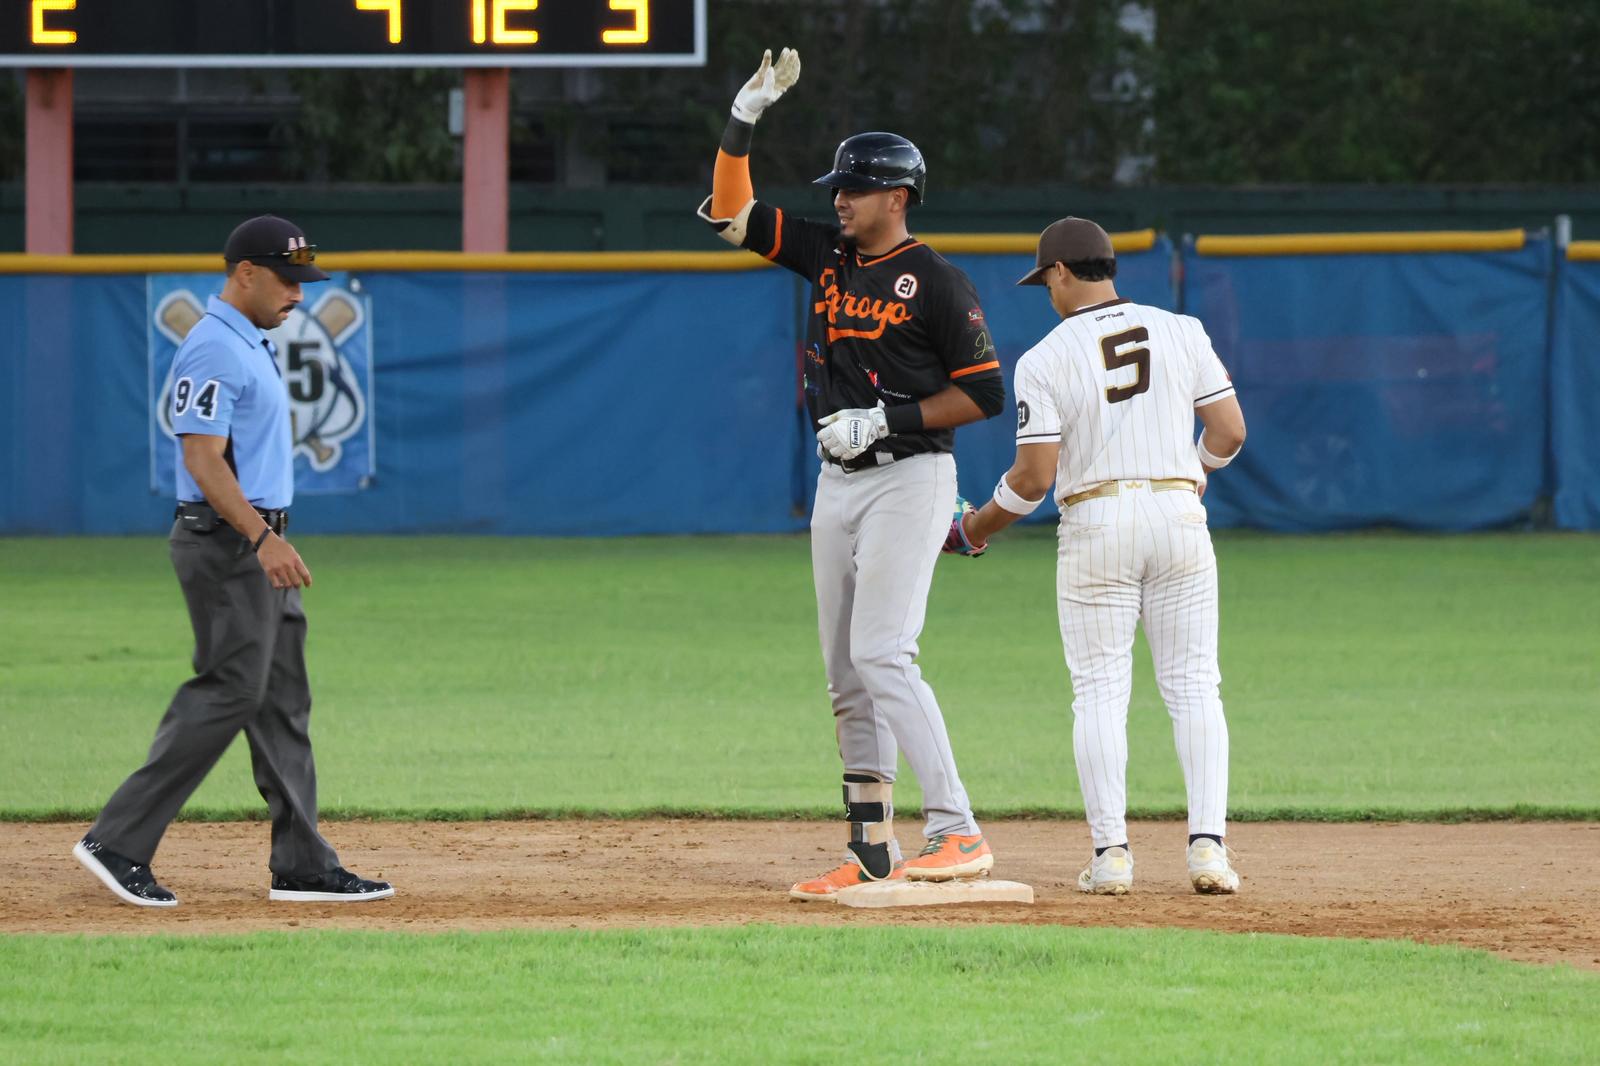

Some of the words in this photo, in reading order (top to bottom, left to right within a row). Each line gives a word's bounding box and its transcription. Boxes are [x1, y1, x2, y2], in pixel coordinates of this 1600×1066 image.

[815, 267, 913, 343] Arroyo
[897, 277, 914, 296] 21
[174, 376, 220, 420] 94
